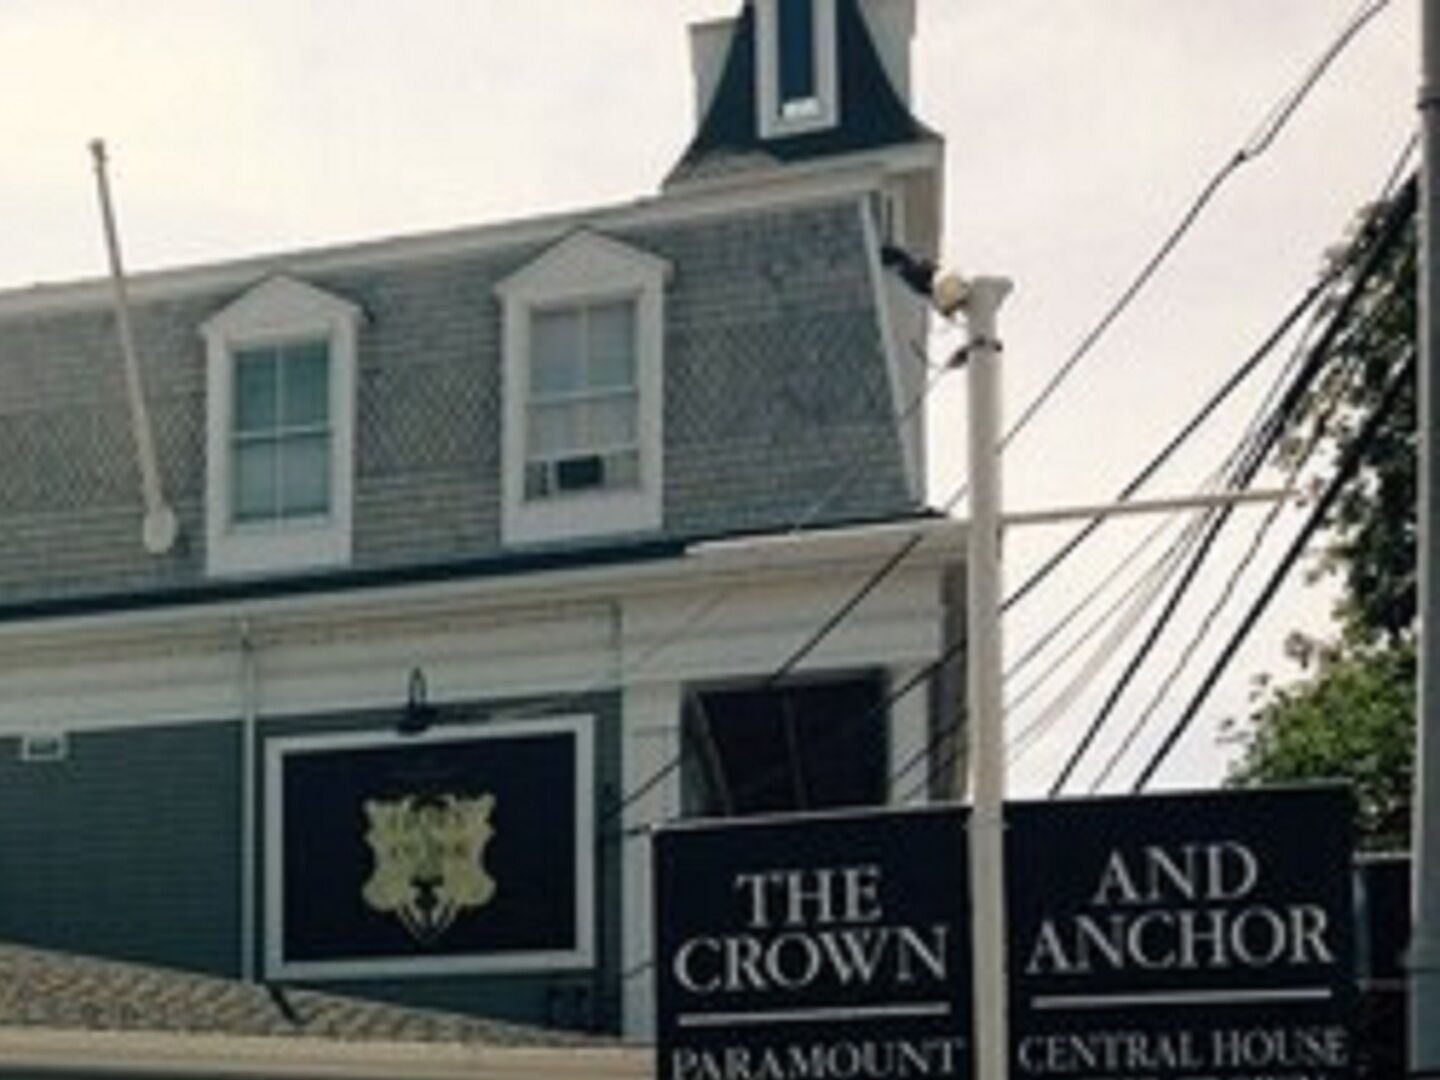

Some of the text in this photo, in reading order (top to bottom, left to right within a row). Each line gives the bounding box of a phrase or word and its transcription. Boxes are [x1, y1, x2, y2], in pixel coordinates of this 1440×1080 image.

[736, 866, 882, 923] THE
[1093, 842, 1257, 904] AND
[673, 924, 947, 991] CROWN
[1027, 904, 1333, 973] ANCHOR
[1018, 1029, 1347, 1070] CENTRAL HOUSE
